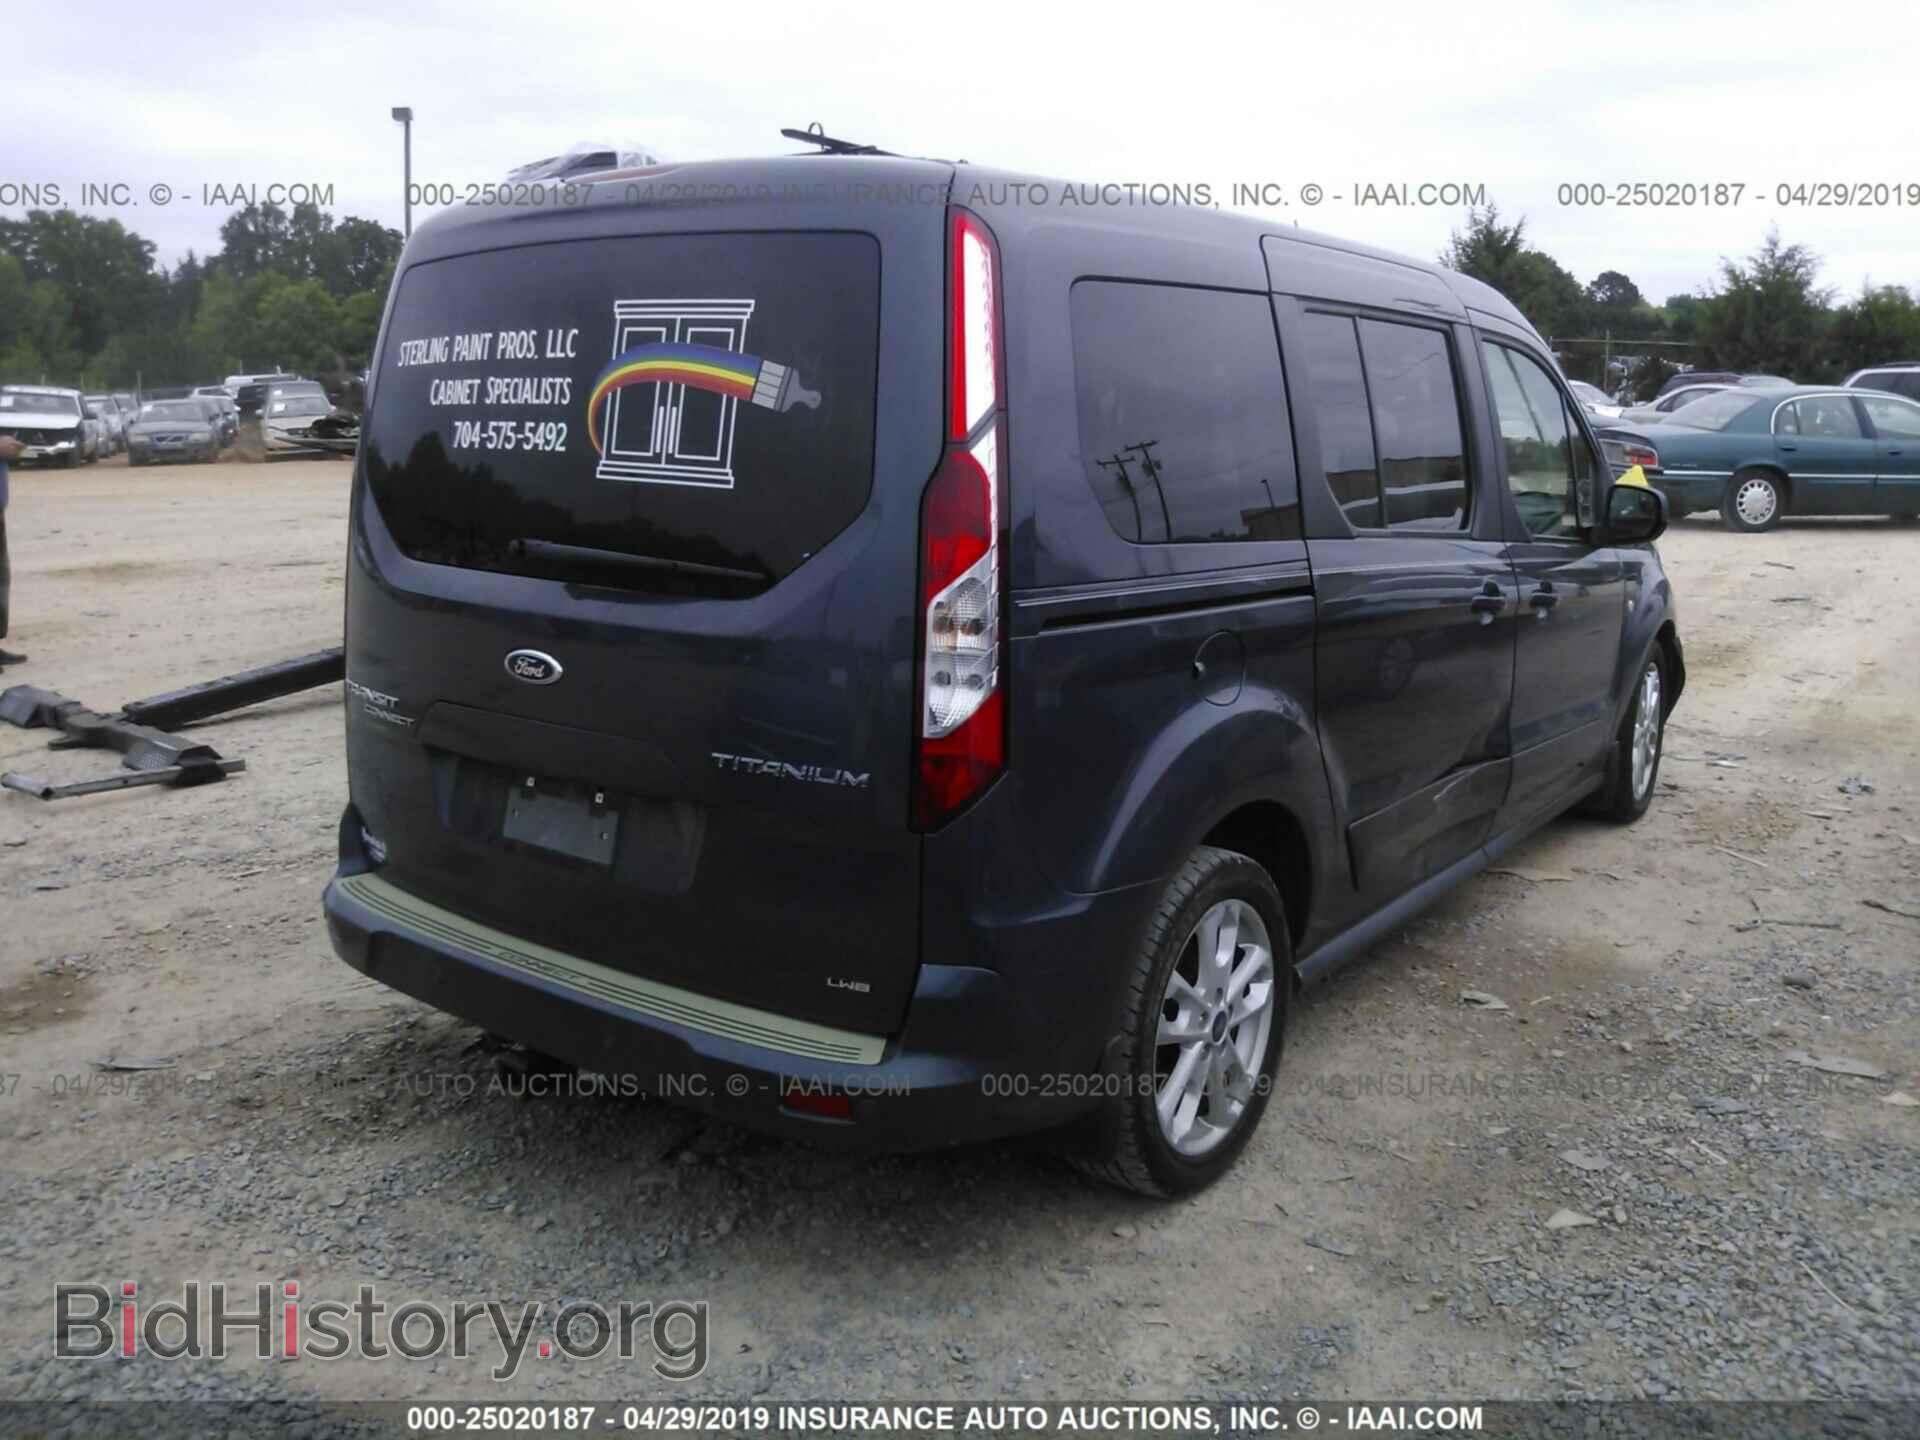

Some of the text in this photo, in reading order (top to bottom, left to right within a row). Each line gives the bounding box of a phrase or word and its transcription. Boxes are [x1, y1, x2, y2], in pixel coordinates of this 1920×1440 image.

[398, 328, 579, 367] STERLING PAINT PROS. LLC
[430, 376, 572, 405] CABINET SPECIALISTS
[453, 421, 568, 452] 704-575-5492
[711, 751, 871, 790] TITANIUM
